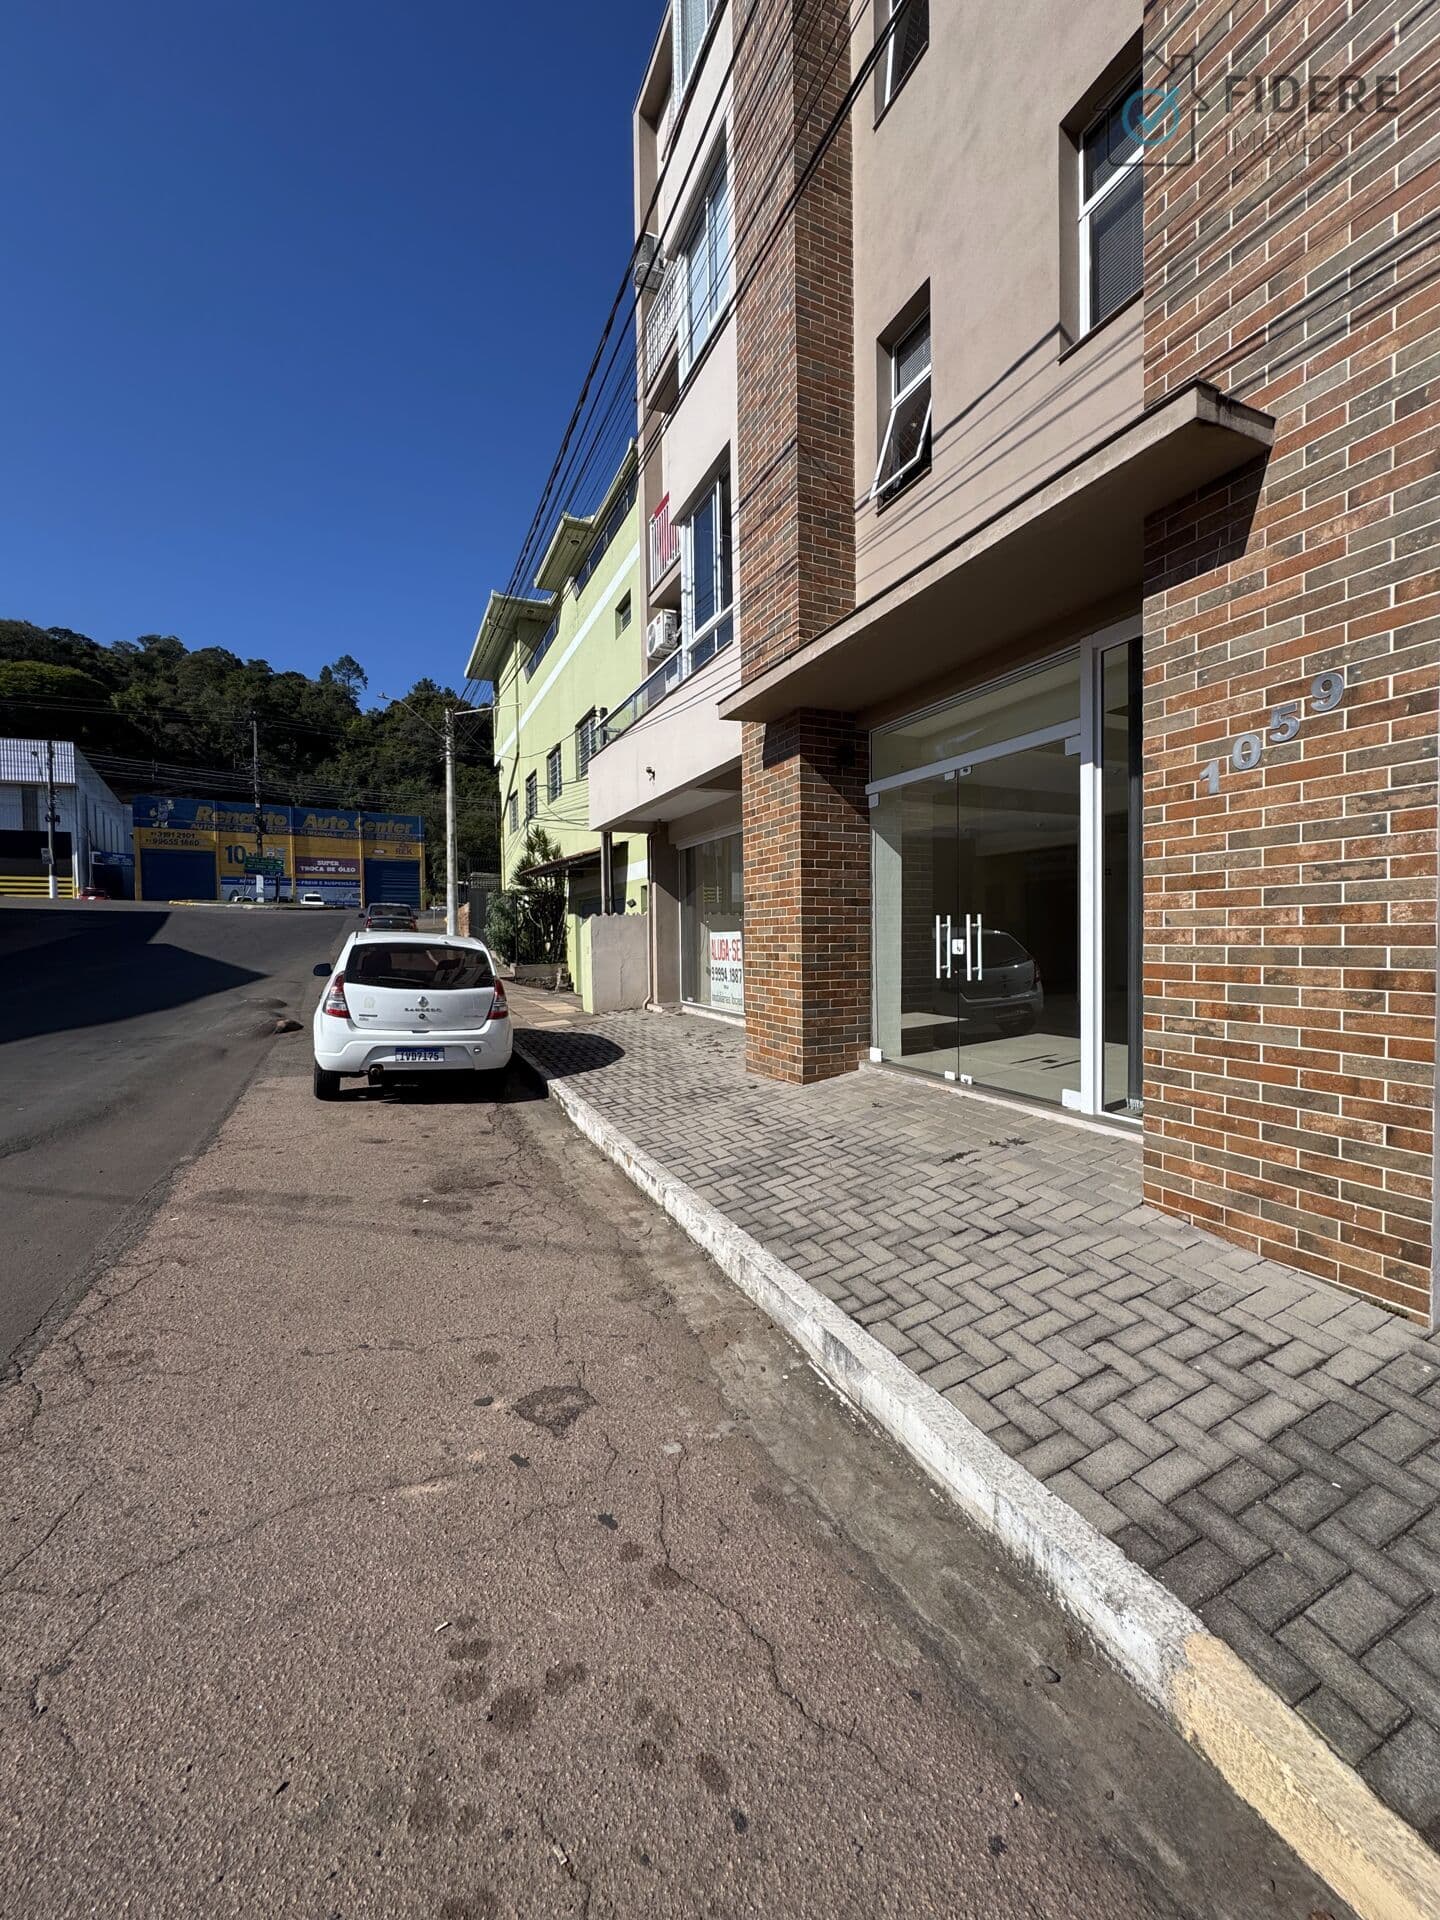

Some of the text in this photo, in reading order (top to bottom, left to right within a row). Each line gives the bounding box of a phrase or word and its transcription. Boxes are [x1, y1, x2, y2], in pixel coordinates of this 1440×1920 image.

[1199, 671, 1345, 796] 1059
[302, 813, 349, 829] Auto
[353, 816, 414, 834] Center
